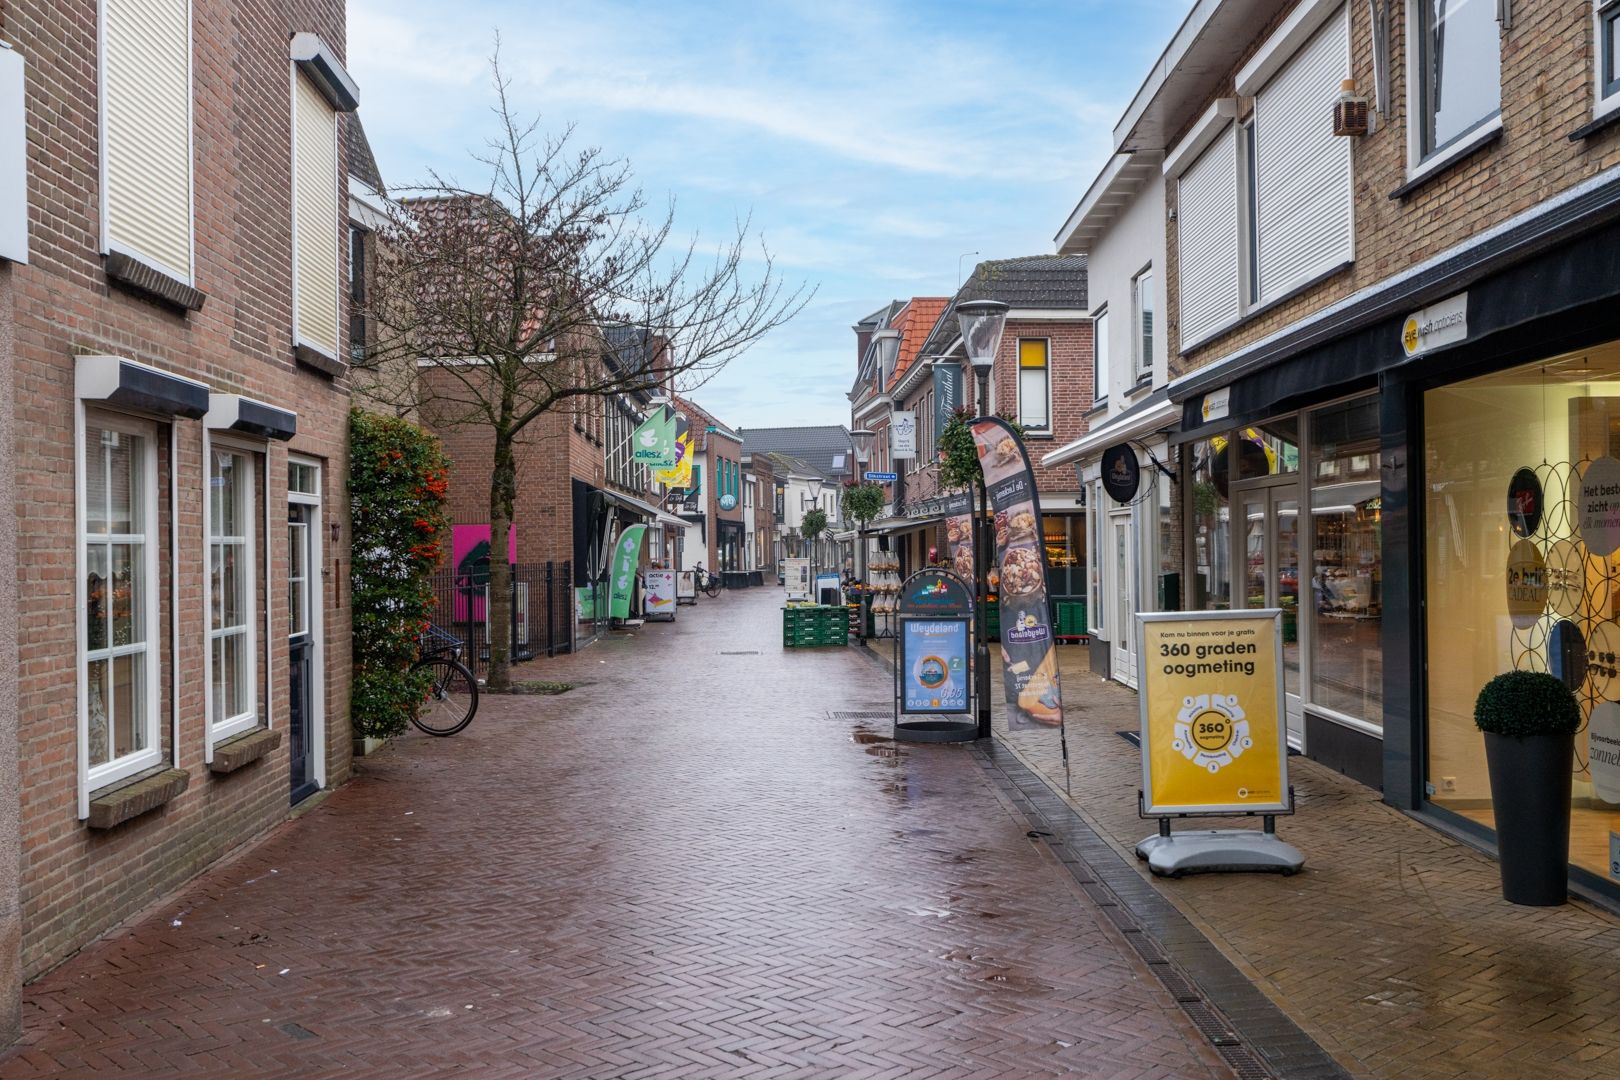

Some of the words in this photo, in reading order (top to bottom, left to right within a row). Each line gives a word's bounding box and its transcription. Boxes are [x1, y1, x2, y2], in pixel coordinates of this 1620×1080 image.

[1583, 485, 1599, 498] Het
[1600, 483, 1620, 496] best
[1587, 500, 1609, 513] zicht
[1508, 567, 1519, 585] 2e
[910, 623, 960, 636] Weydeland
[1186, 630, 1209, 638] binnen
[1227, 630, 1235, 638] je
[1235, 629, 1255, 637] gratis
[1160, 643, 1190, 657] 360
[1195, 641, 1257, 659] graden
[1163, 659, 1255, 678] oogmeting
[1199, 723, 1225, 733] 360
